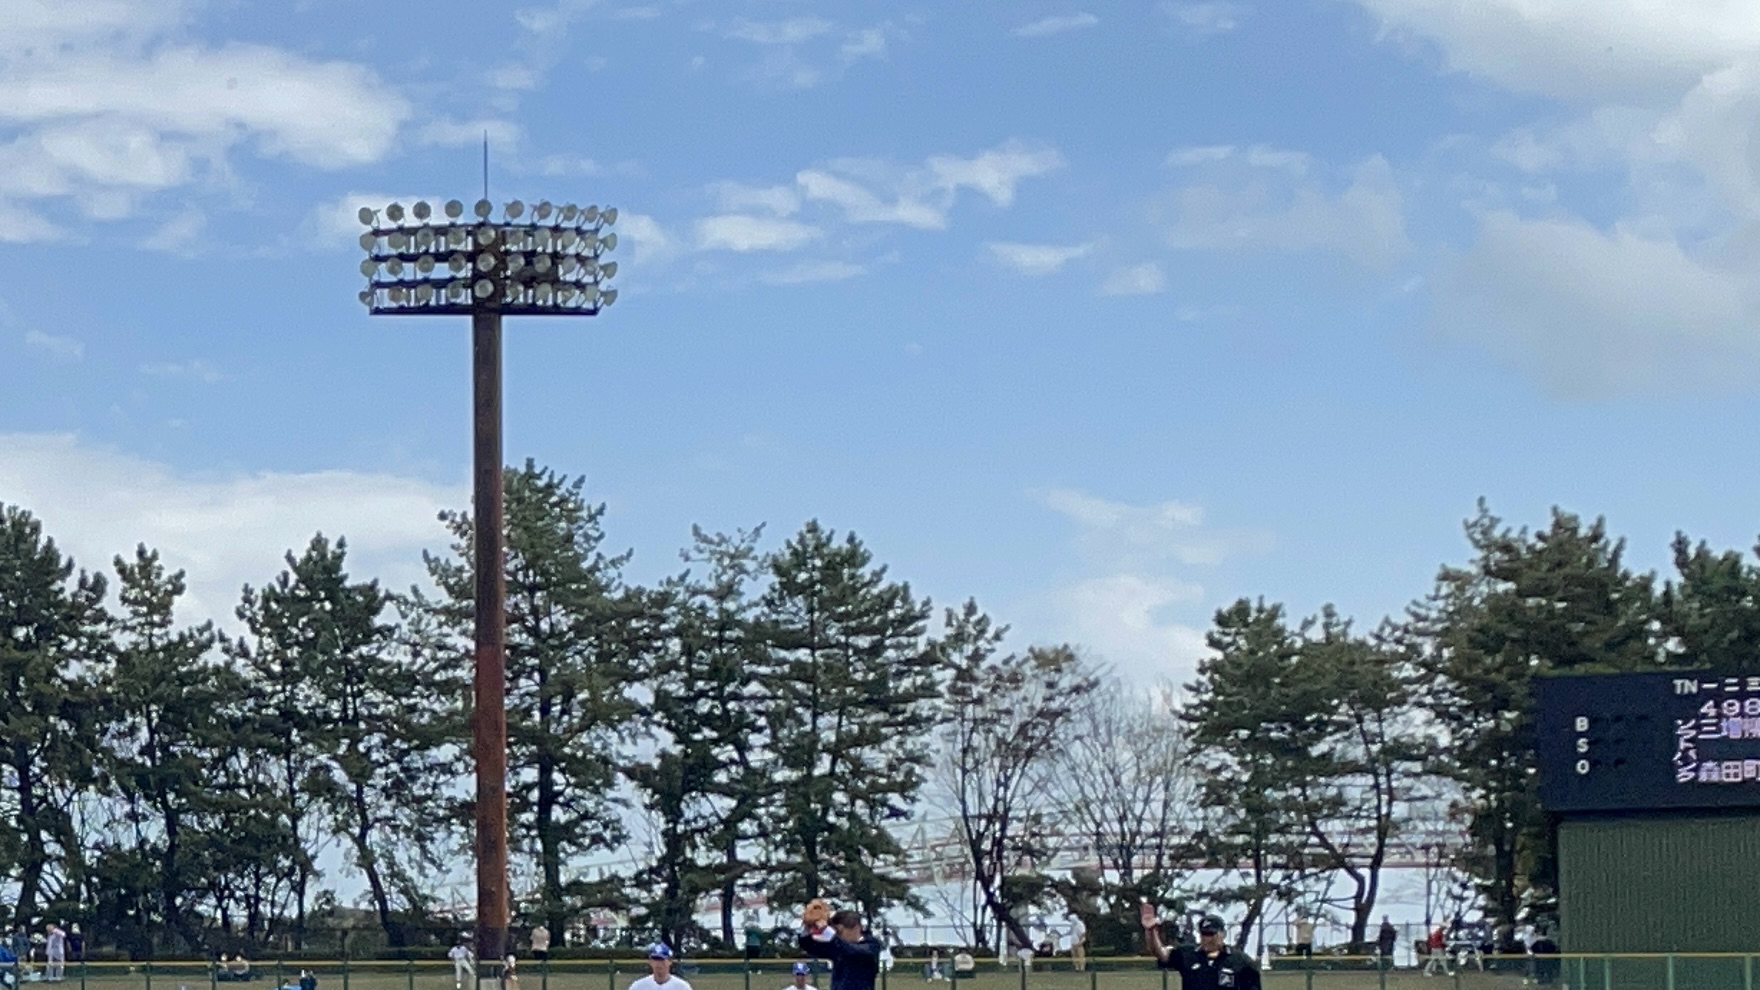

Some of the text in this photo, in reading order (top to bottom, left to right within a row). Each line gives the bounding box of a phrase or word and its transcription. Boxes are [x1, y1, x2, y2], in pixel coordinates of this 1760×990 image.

[1673, 679, 1697, 694] TN
[1700, 700, 1718, 716] 4
[1575, 716, 1589, 731] B
[1577, 738, 1589, 752] S
